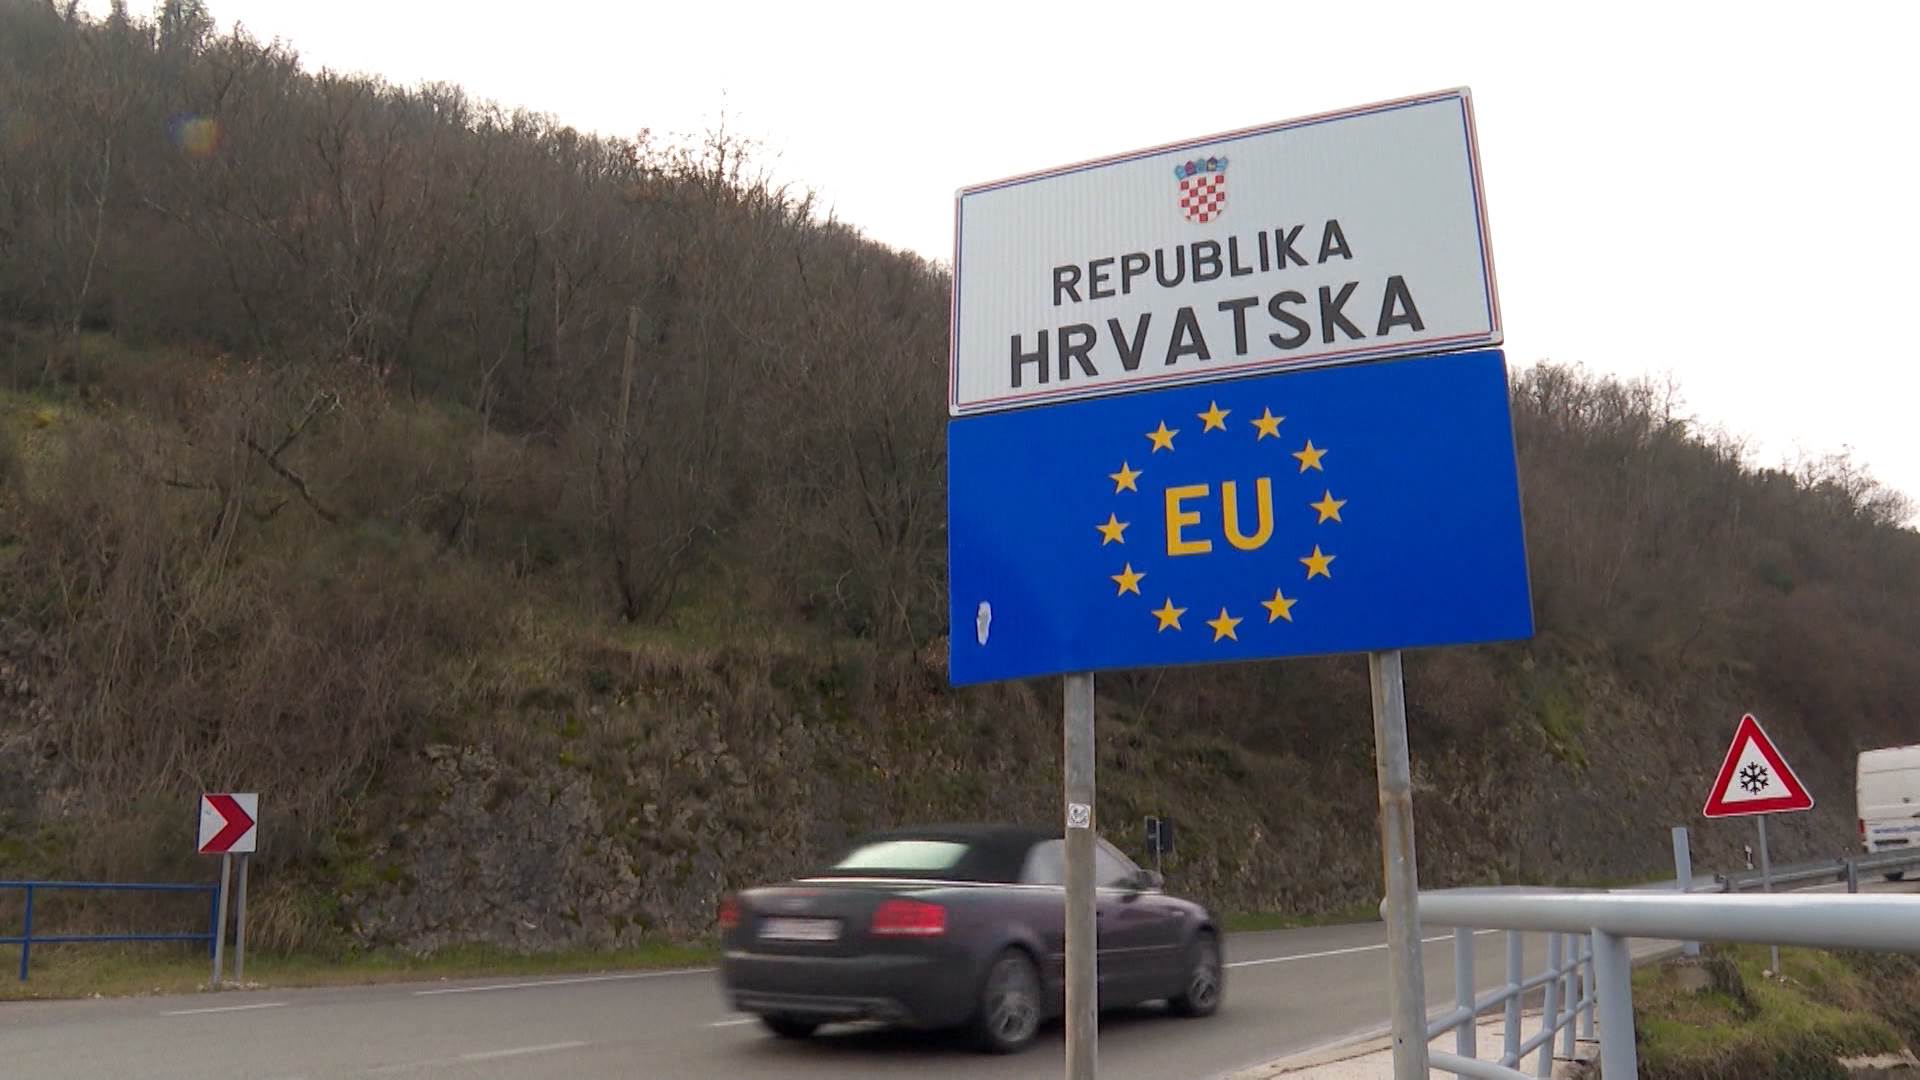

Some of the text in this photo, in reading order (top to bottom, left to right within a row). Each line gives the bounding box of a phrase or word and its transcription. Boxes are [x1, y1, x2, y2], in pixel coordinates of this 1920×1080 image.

[1052, 219, 1353, 307] REPUBLIKA
[1010, 275, 1426, 389] HRVATSKA
[1165, 477, 1274, 556] EU
